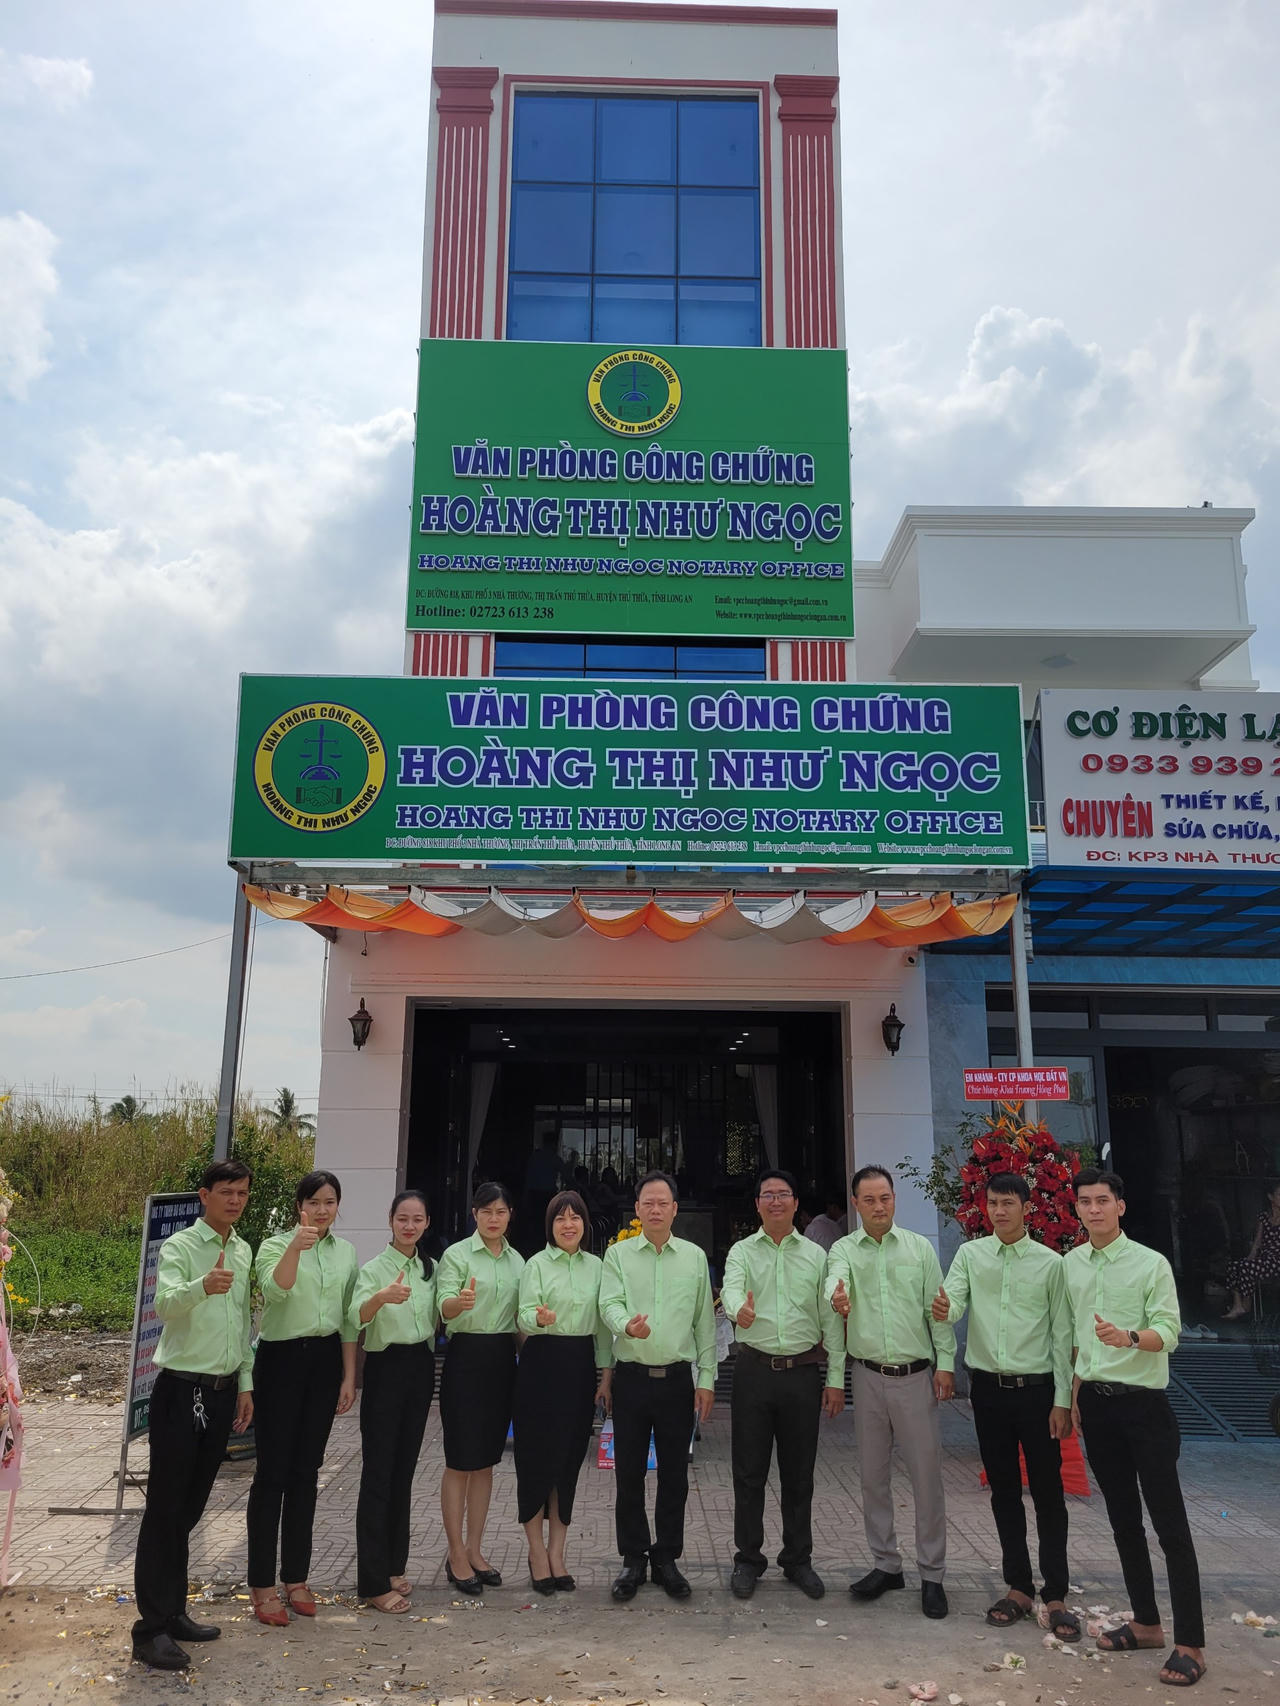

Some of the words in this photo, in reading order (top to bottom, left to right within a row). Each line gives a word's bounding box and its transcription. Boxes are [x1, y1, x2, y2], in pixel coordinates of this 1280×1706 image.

[452, 438, 512, 479] VĂN
[517, 440, 618, 482] PHÒNG
[623, 442, 705, 484] CÔNG
[709, 445, 815, 487] CHỨNG
[420, 484, 562, 537] HOÀNG
[564, 498, 631, 548] THỊ
[635, 497, 725, 540] NHƯ
[727, 501, 843, 553] NGỌC
[418, 554, 501, 571] HOANG
[503, 556, 543, 572] THI
[545, 557, 595, 574] NHU
[597, 558, 664, 575] NGOC
[667, 560, 758, 577] NOTARY
[760, 561, 845, 579] OFFICE
[415, 604, 466, 618] Hotline:
[469, 605, 505, 618] 02723
[508, 606, 529, 619] 613
[533, 606, 554, 619] 238
[446, 687, 529, 729] VĂN
[540, 688, 678, 731] PHÒNG
[688, 690, 801, 733] CÔNG
[811, 692, 951, 734] CHỨNG
[278, 707, 316, 732] PHÒNG
[320, 705, 352, 724] CÔNG
[351, 719, 380, 755] CHỨNG
[1066, 706, 1120, 738] CƠ
[1130, 704, 1227, 748] ĐIỆN
[396, 735, 596, 789] HOÀNG
[606, 747, 699, 799] THỊ
[708, 746, 833, 792] NHƯ
[838, 750, 1002, 802] NGỌC
[1081, 753, 1180, 775] 0933
[1190, 755, 1263, 776] 939
[1062, 792, 1154, 837] CHUYÊN
[1161, 789, 1227, 810] THIẾT
[1234, 790, 1270, 814] KẾ,
[295, 814, 318, 831] THỊ
[321, 809, 350, 829] NHƯ
[395, 804, 512, 830] HOANG
[517, 805, 573, 830] THI
[577, 807, 647, 831] NHU
[653, 807, 748, 832] NGOC
[752, 808, 880, 834] NOTARY
[884, 809, 1004, 835] OFFICE
[1164, 817, 1207, 839] SỬA
[1212, 820, 1280, 843] CHỮA,
[1086, 850, 1121, 862] ĐC:
[1128, 851, 1169, 863] KP3
[1175, 849, 1219, 864] NHÀ
[997, 1072, 1008, 1082] CTY
[1017, 1072, 1032, 1082] KHOA
